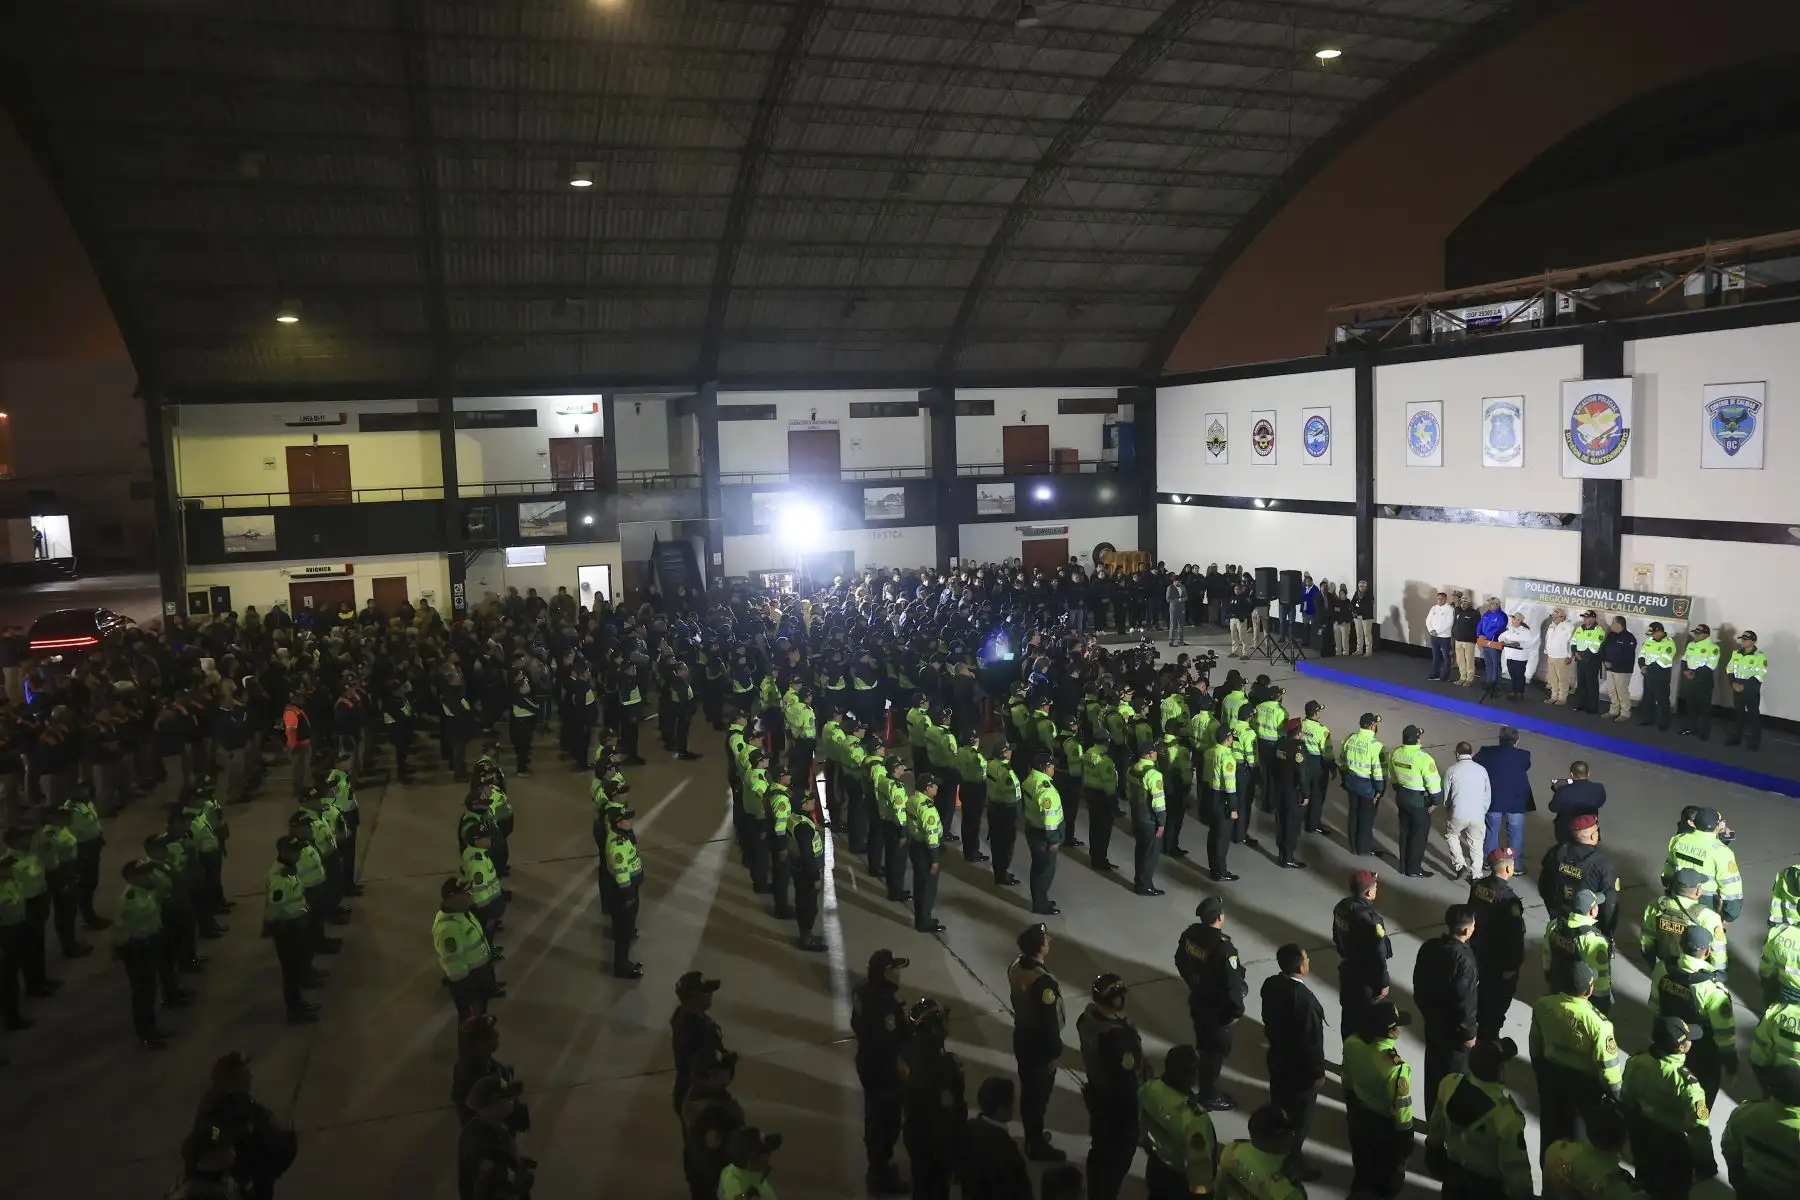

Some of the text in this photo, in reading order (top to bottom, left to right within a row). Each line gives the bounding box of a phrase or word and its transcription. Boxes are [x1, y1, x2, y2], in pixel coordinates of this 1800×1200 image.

[1726, 440, 1738, 450] QC
[1525, 582, 1668, 608] POLICÍA NACIONAL DEL PERÚ
[1571, 597, 1609, 610] POLICIAL
[1610, 602, 1647, 615] CALLAO
